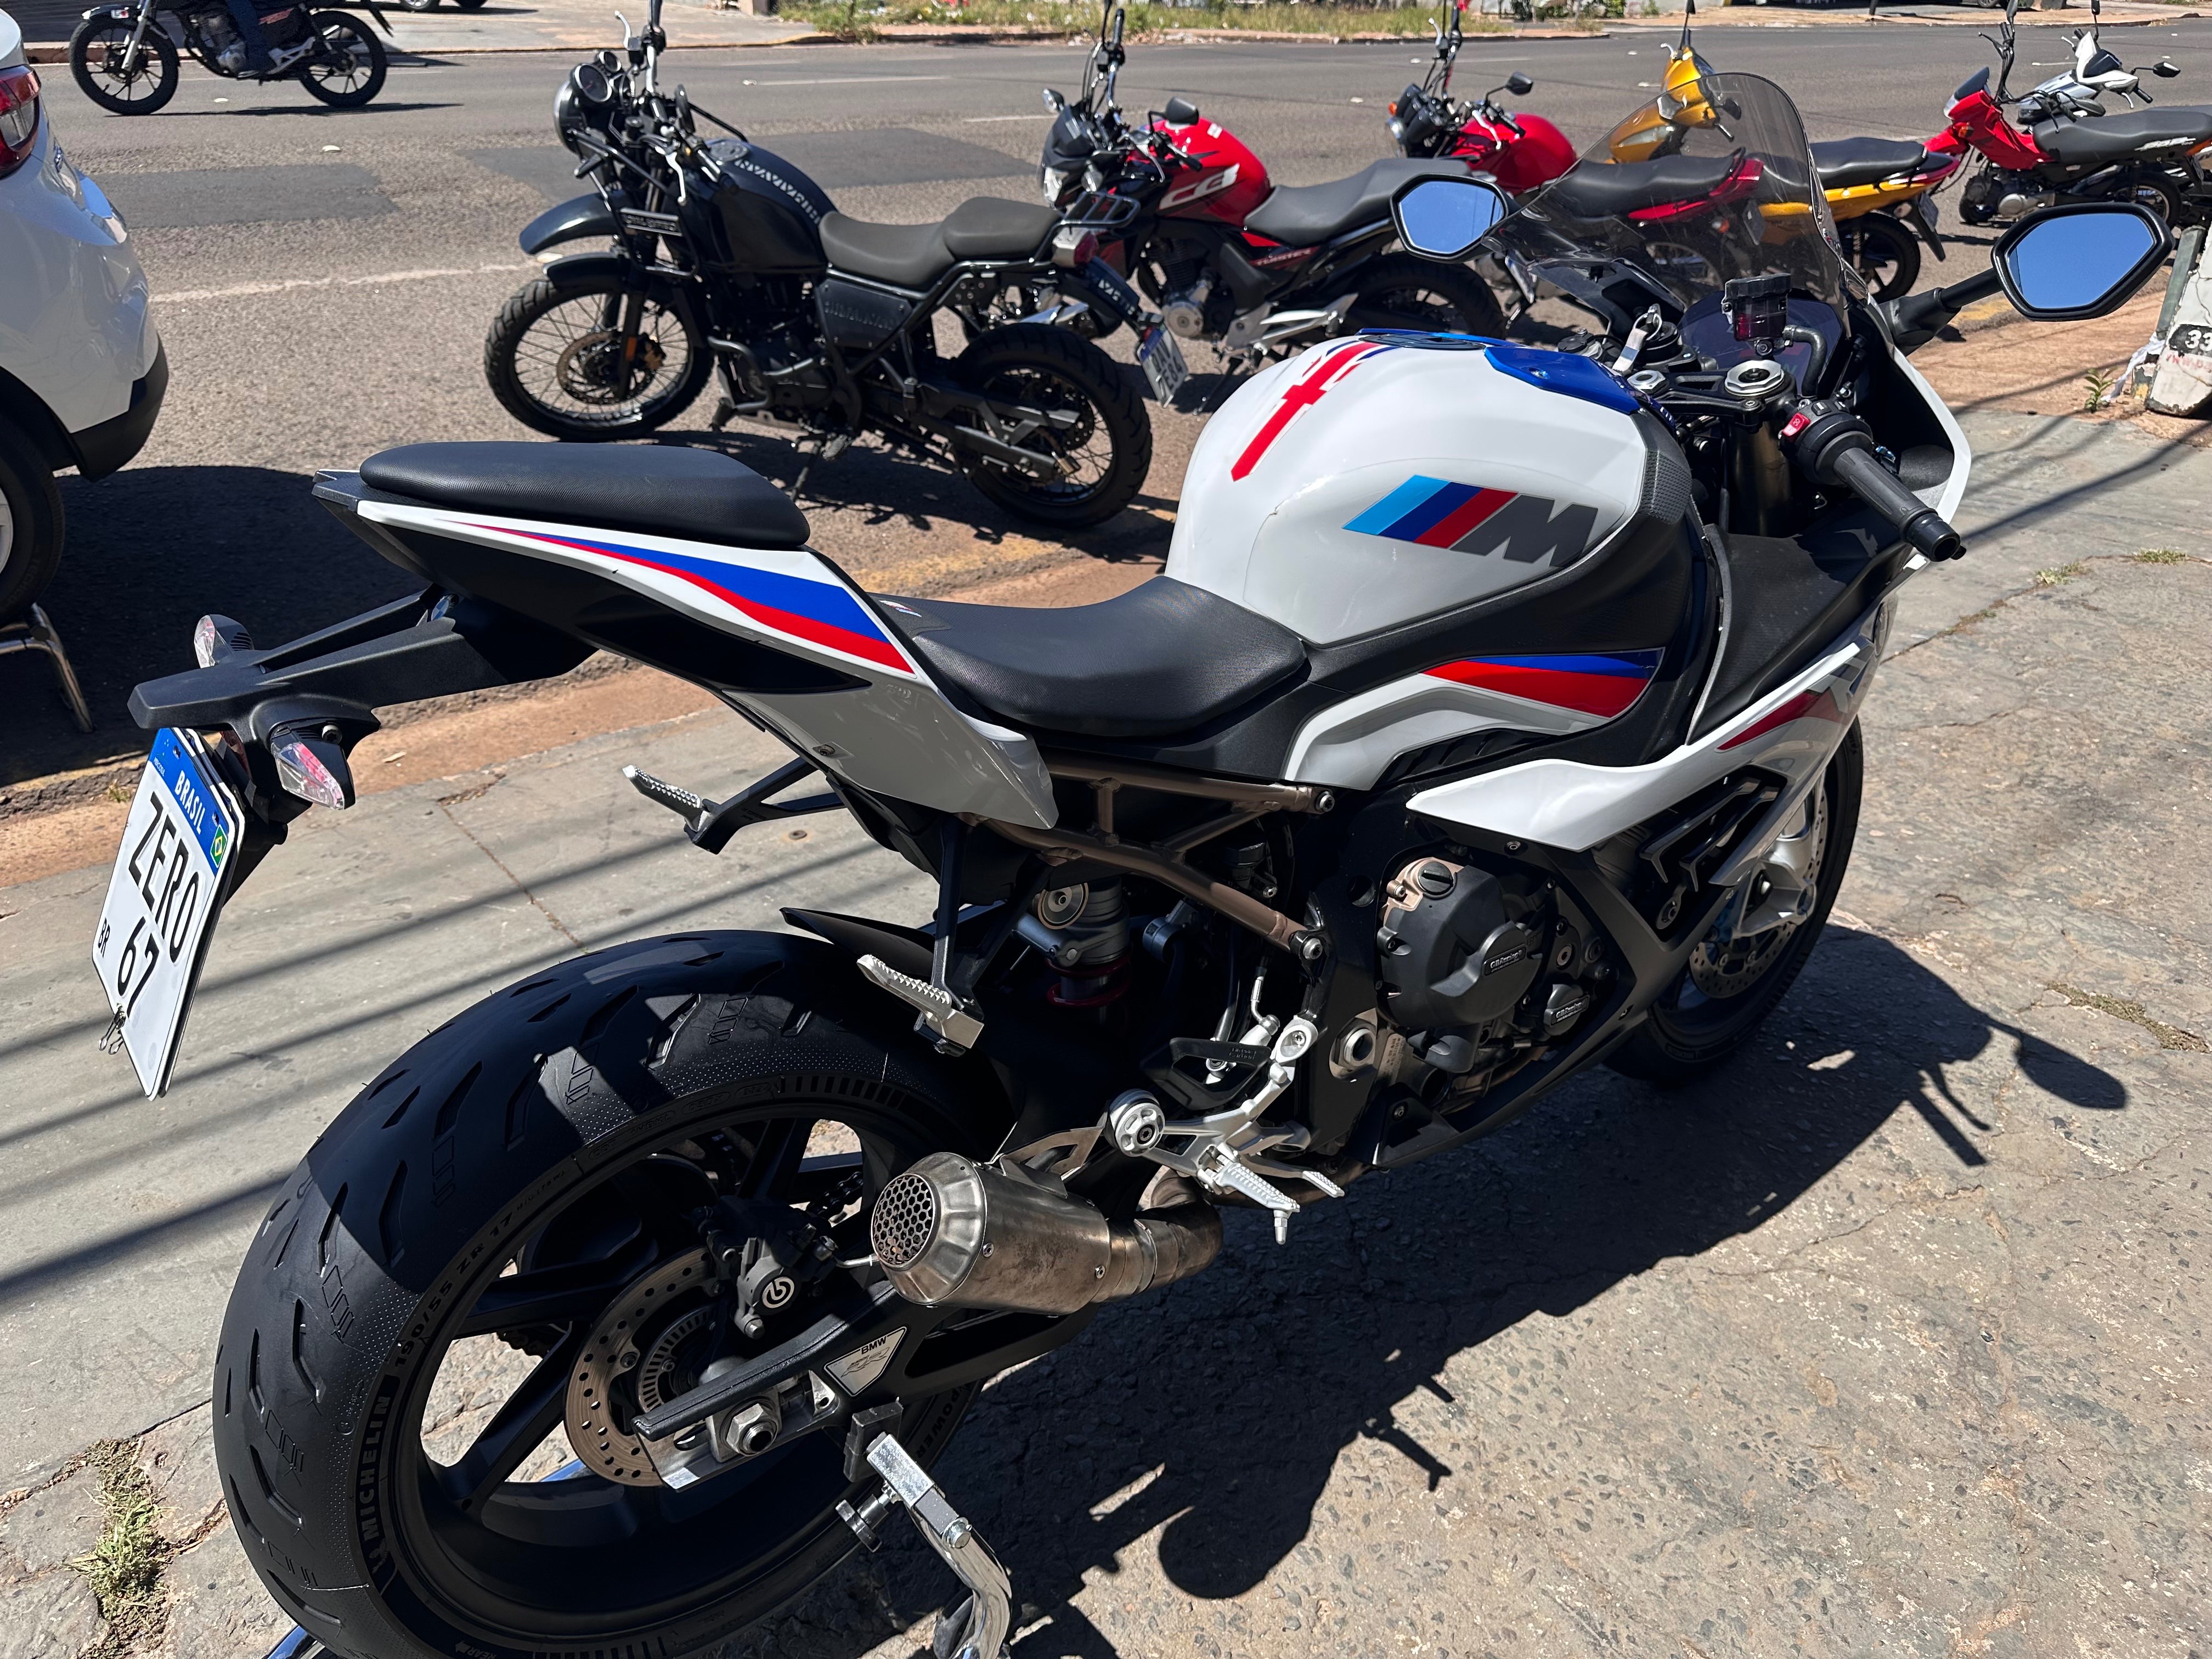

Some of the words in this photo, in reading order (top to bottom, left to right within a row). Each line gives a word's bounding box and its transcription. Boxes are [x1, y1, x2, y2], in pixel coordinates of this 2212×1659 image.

[1159, 163, 1240, 210] CB
[1450, 494, 1598, 567] M
[174, 770, 206, 834] BRASIL
[128, 791, 199, 963] ZERO
[98, 917, 110, 958] BR
[117, 916, 160, 1018] 67
[359, 1395, 391, 1544] MICHELIN
[394, 1279, 453, 1367] 190/55
[456, 1241, 485, 1274] ZR
[489, 1210, 514, 1235] 17
[861, 1335, 887, 1355] BMW
